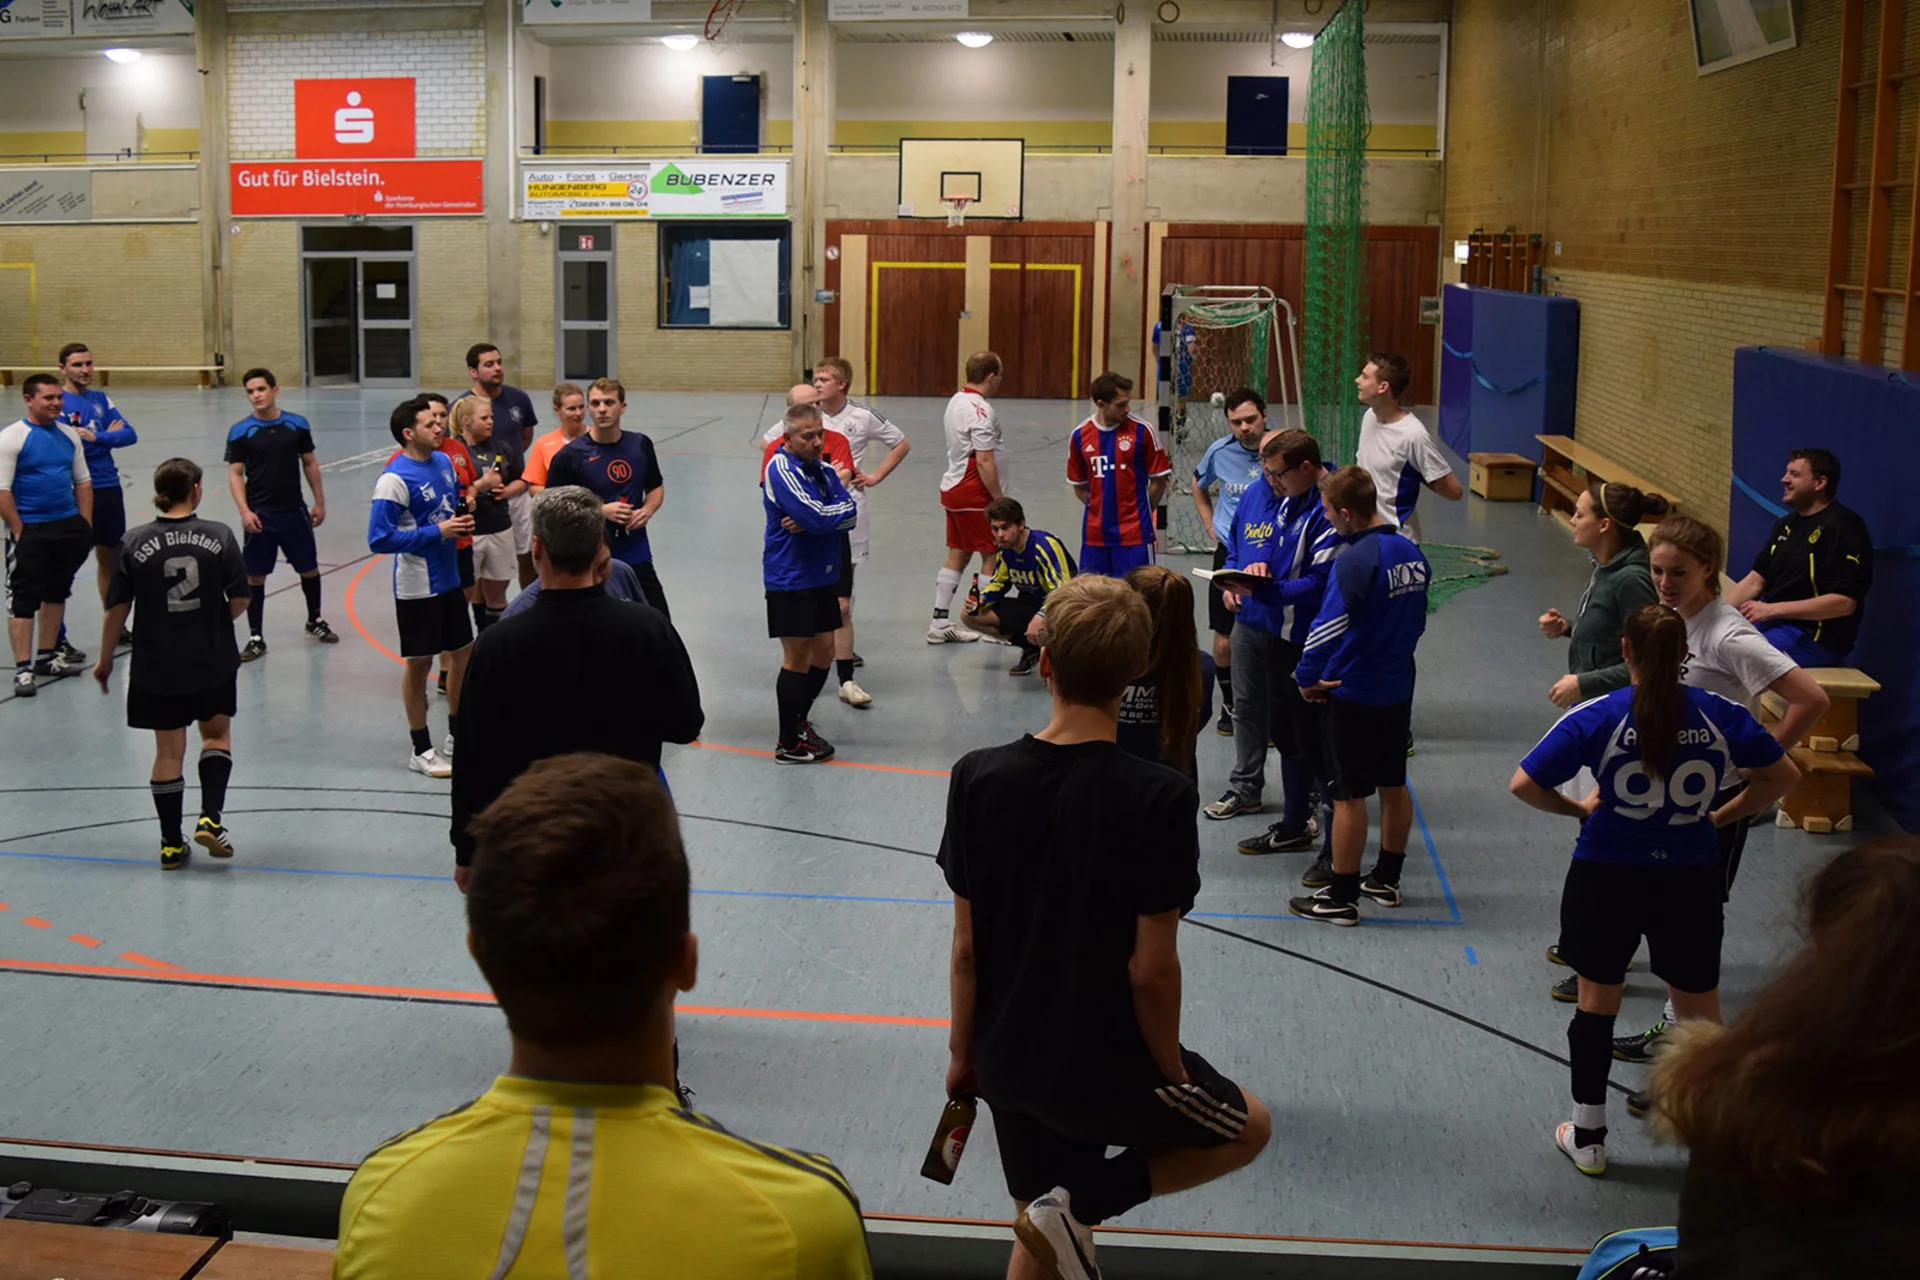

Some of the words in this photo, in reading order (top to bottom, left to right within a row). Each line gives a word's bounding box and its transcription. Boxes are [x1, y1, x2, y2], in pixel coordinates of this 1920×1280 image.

[238, 171, 269, 187] Gut
[273, 170, 298, 186] für
[302, 168, 385, 186] Bielstein.
[528, 173, 554, 181] Auto
[566, 173, 596, 181] Forst
[609, 172, 648, 180] Garten
[666, 173, 775, 186] BUBENZER
[630, 184, 643, 195] 24
[384, 195, 415, 203] Sparkasse
[396, 202, 441, 210] Homburgischen
[612, 464, 627, 478] 90
[134, 537, 161, 563] BSV
[165, 530, 222, 554] Bielstein
[164, 555, 200, 612] 2
[1623, 727, 1711, 746] Aena
[1613, 759, 1717, 825] 99
